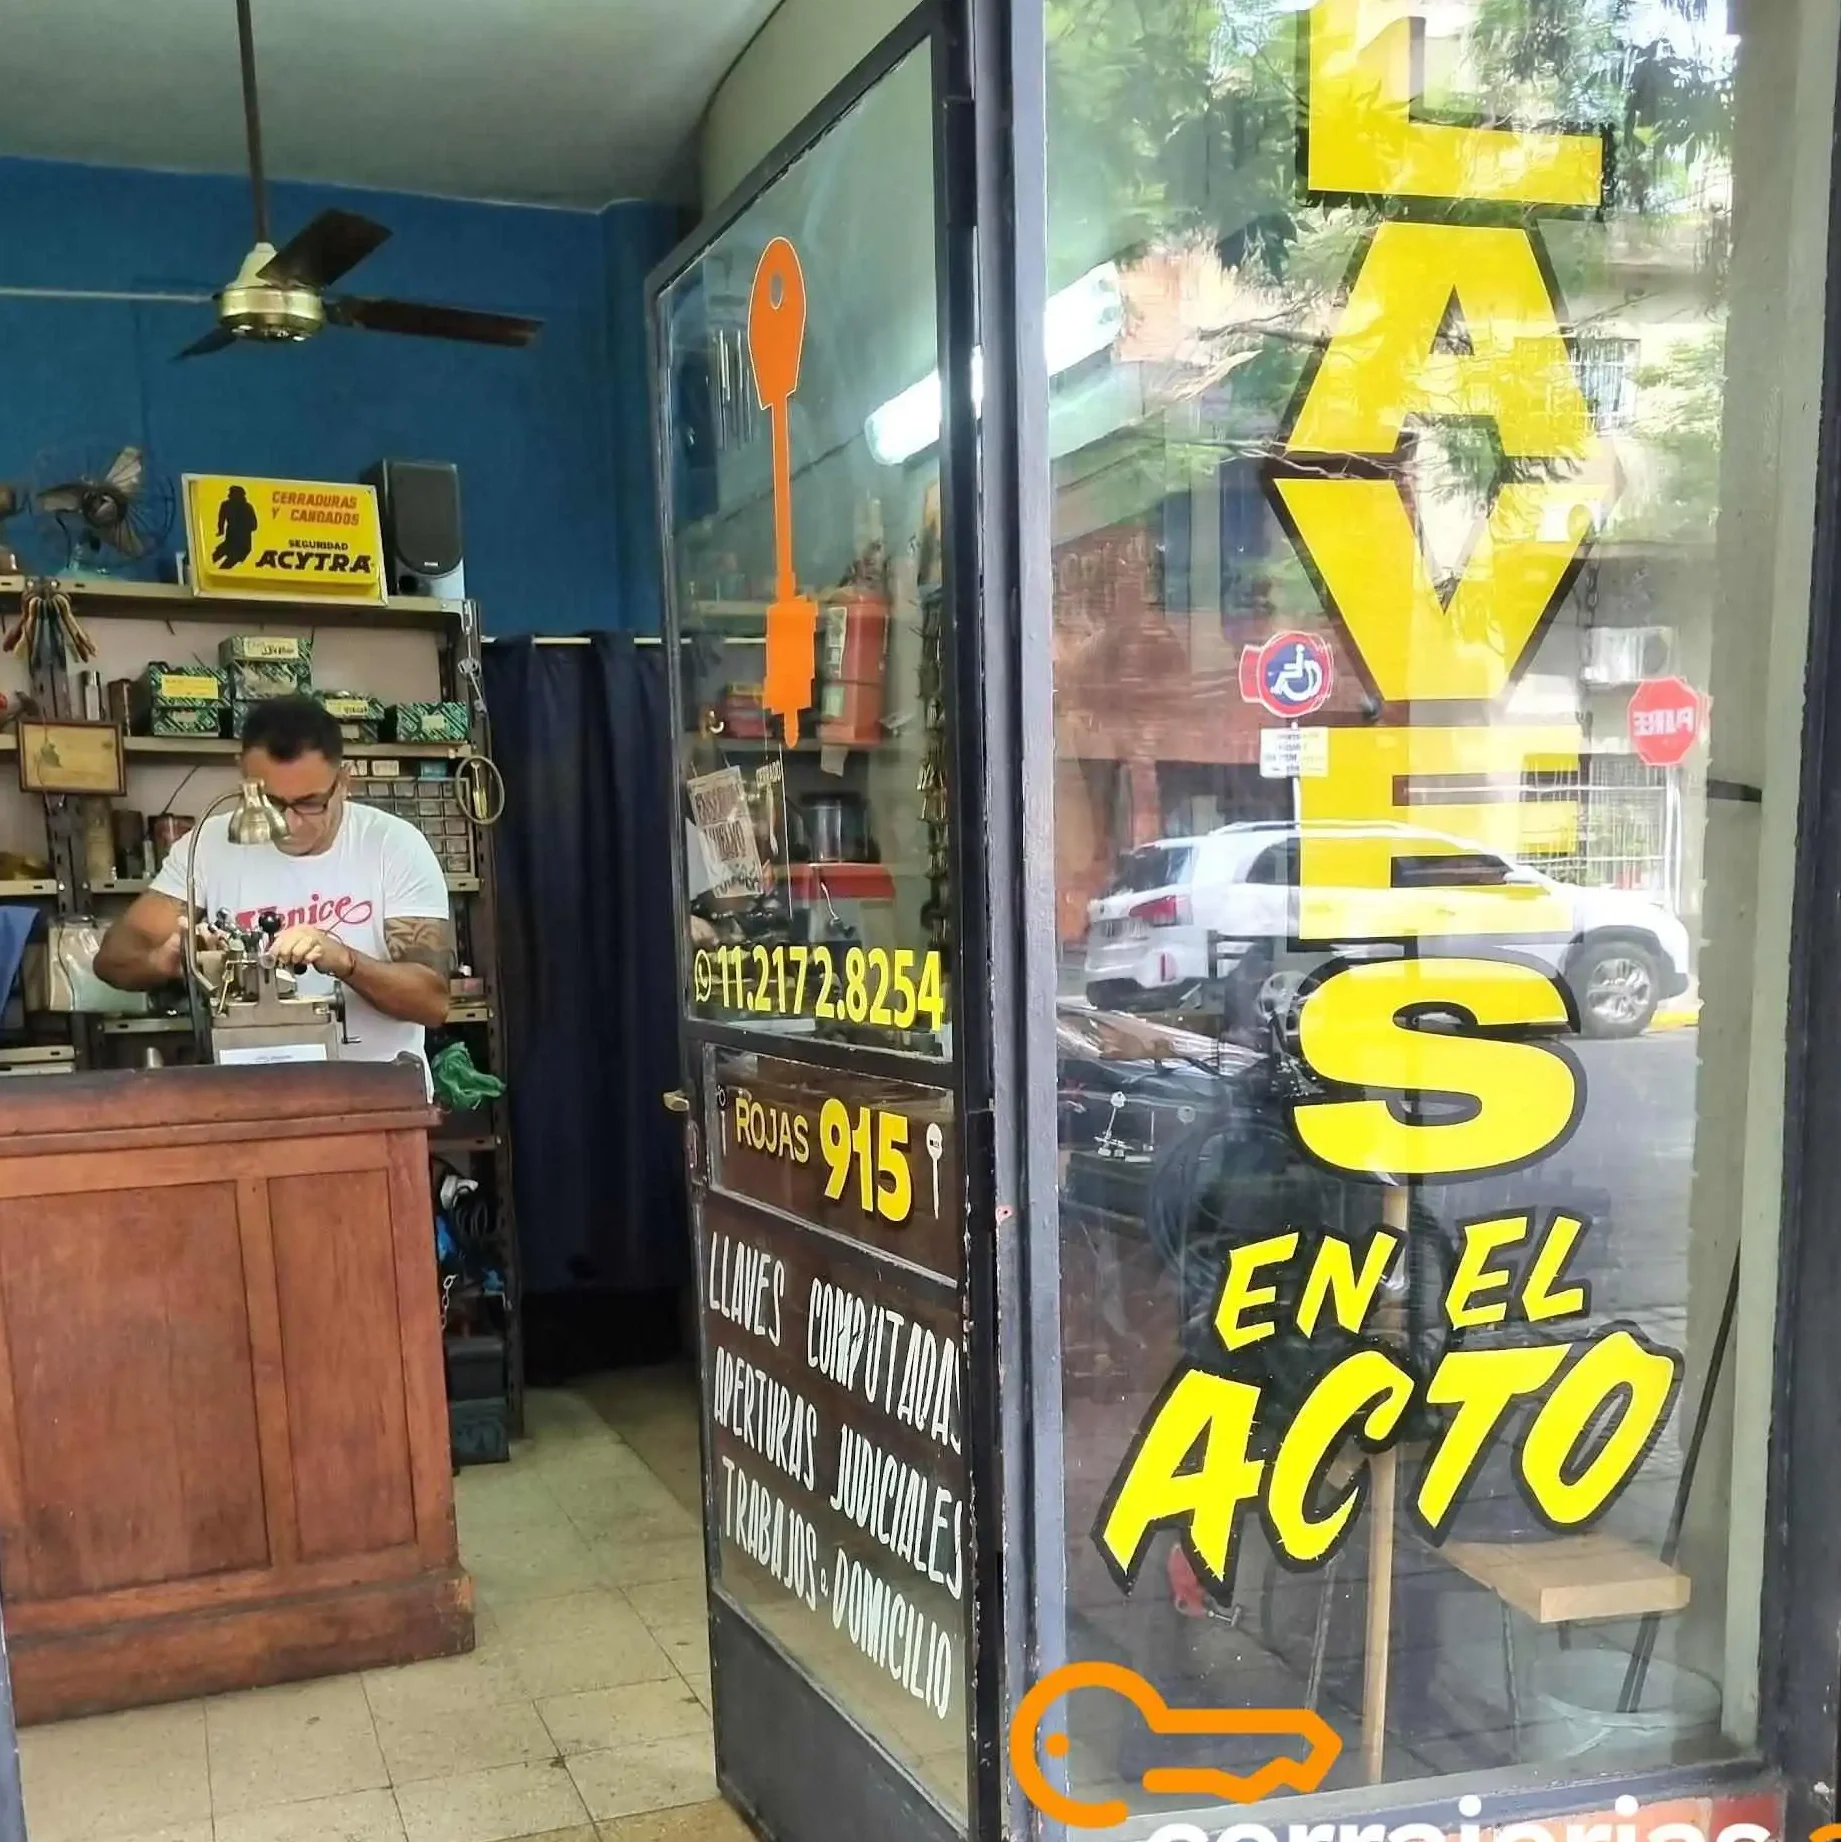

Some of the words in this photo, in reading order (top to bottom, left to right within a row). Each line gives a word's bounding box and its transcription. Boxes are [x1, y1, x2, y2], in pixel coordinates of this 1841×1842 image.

[271, 491, 358, 509] CERRADURAS
[271, 507, 280, 520] Y
[290, 508, 360, 526] CANDADOS
[288, 538, 349, 551] SEGURIDAD
[255, 549, 372, 573] ACYTRA
[717, 944, 945, 1033] 11.2172.8254
[735, 1096, 810, 1164] ROJAS
[819, 1097, 912, 1222] 915
[709, 1230, 785, 1347] LLAVES
[1213, 1230, 1400, 1352] EN
[1444, 1214, 1586, 1330] EL
[714, 1345, 817, 1492] APERTURAS
[829, 1423, 964, 1600] JUDICIALES
[1101, 1329, 1675, 1583] ACTO
[721, 1455, 817, 1611] TRABAJOS
[832, 1547, 953, 1720] DOMICILIO
